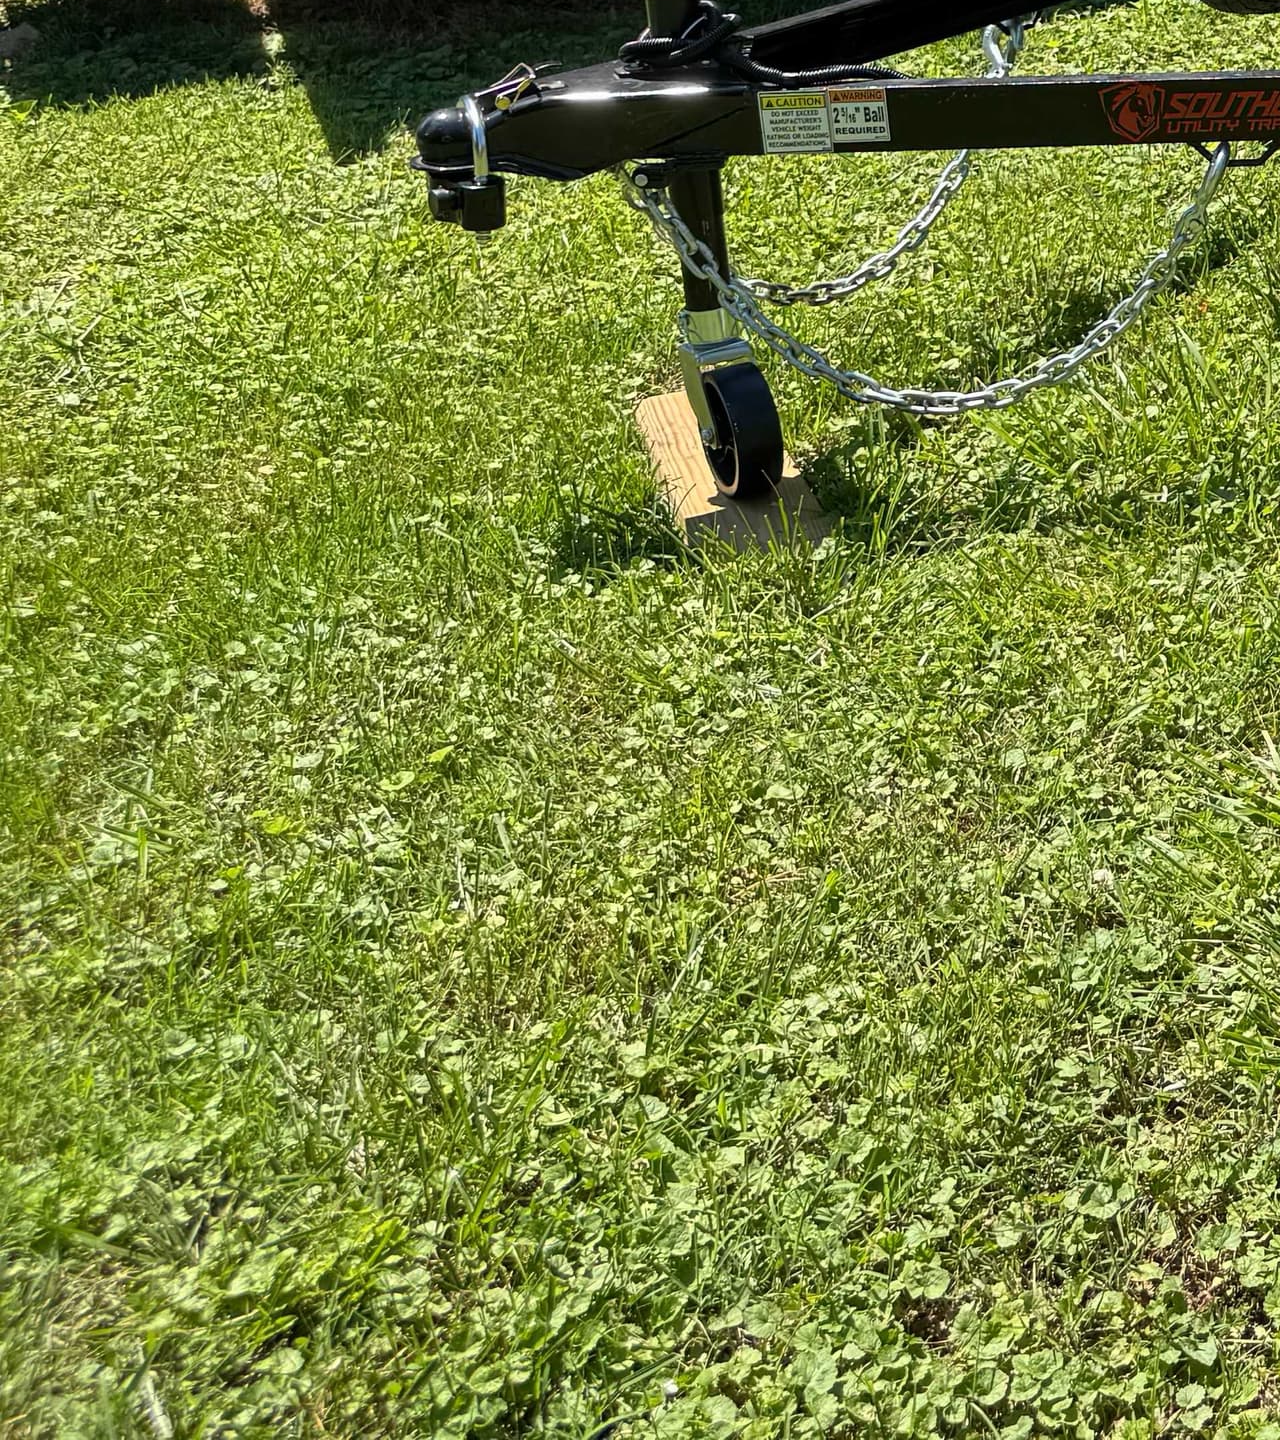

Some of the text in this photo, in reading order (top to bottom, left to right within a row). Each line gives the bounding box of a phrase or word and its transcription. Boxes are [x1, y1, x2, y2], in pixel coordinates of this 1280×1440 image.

[840, 90, 883, 100] WARNING
[776, 97, 822, 107] CAUTION
[864, 106, 885, 123] Ball
[835, 126, 886, 135] REQUIRED
[1167, 118, 1239, 134] UTILITY
